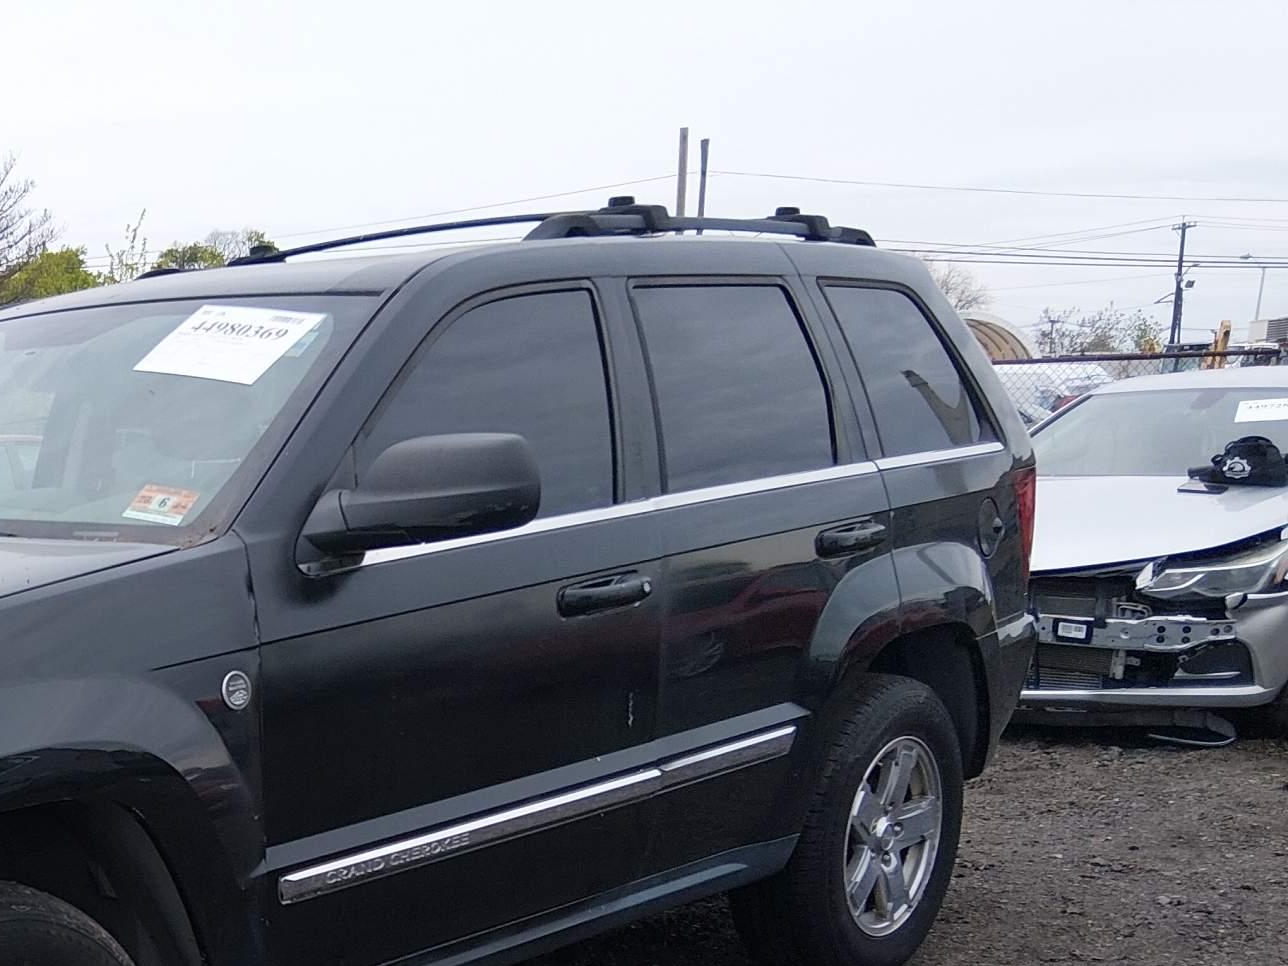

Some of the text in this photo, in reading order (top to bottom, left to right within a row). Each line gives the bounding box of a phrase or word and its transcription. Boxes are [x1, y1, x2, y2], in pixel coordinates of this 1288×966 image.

[192, 320, 289, 341] 44980369
[158, 497, 171, 508] 6
[326, 832, 471, 884] GRAND CHEROKEE
